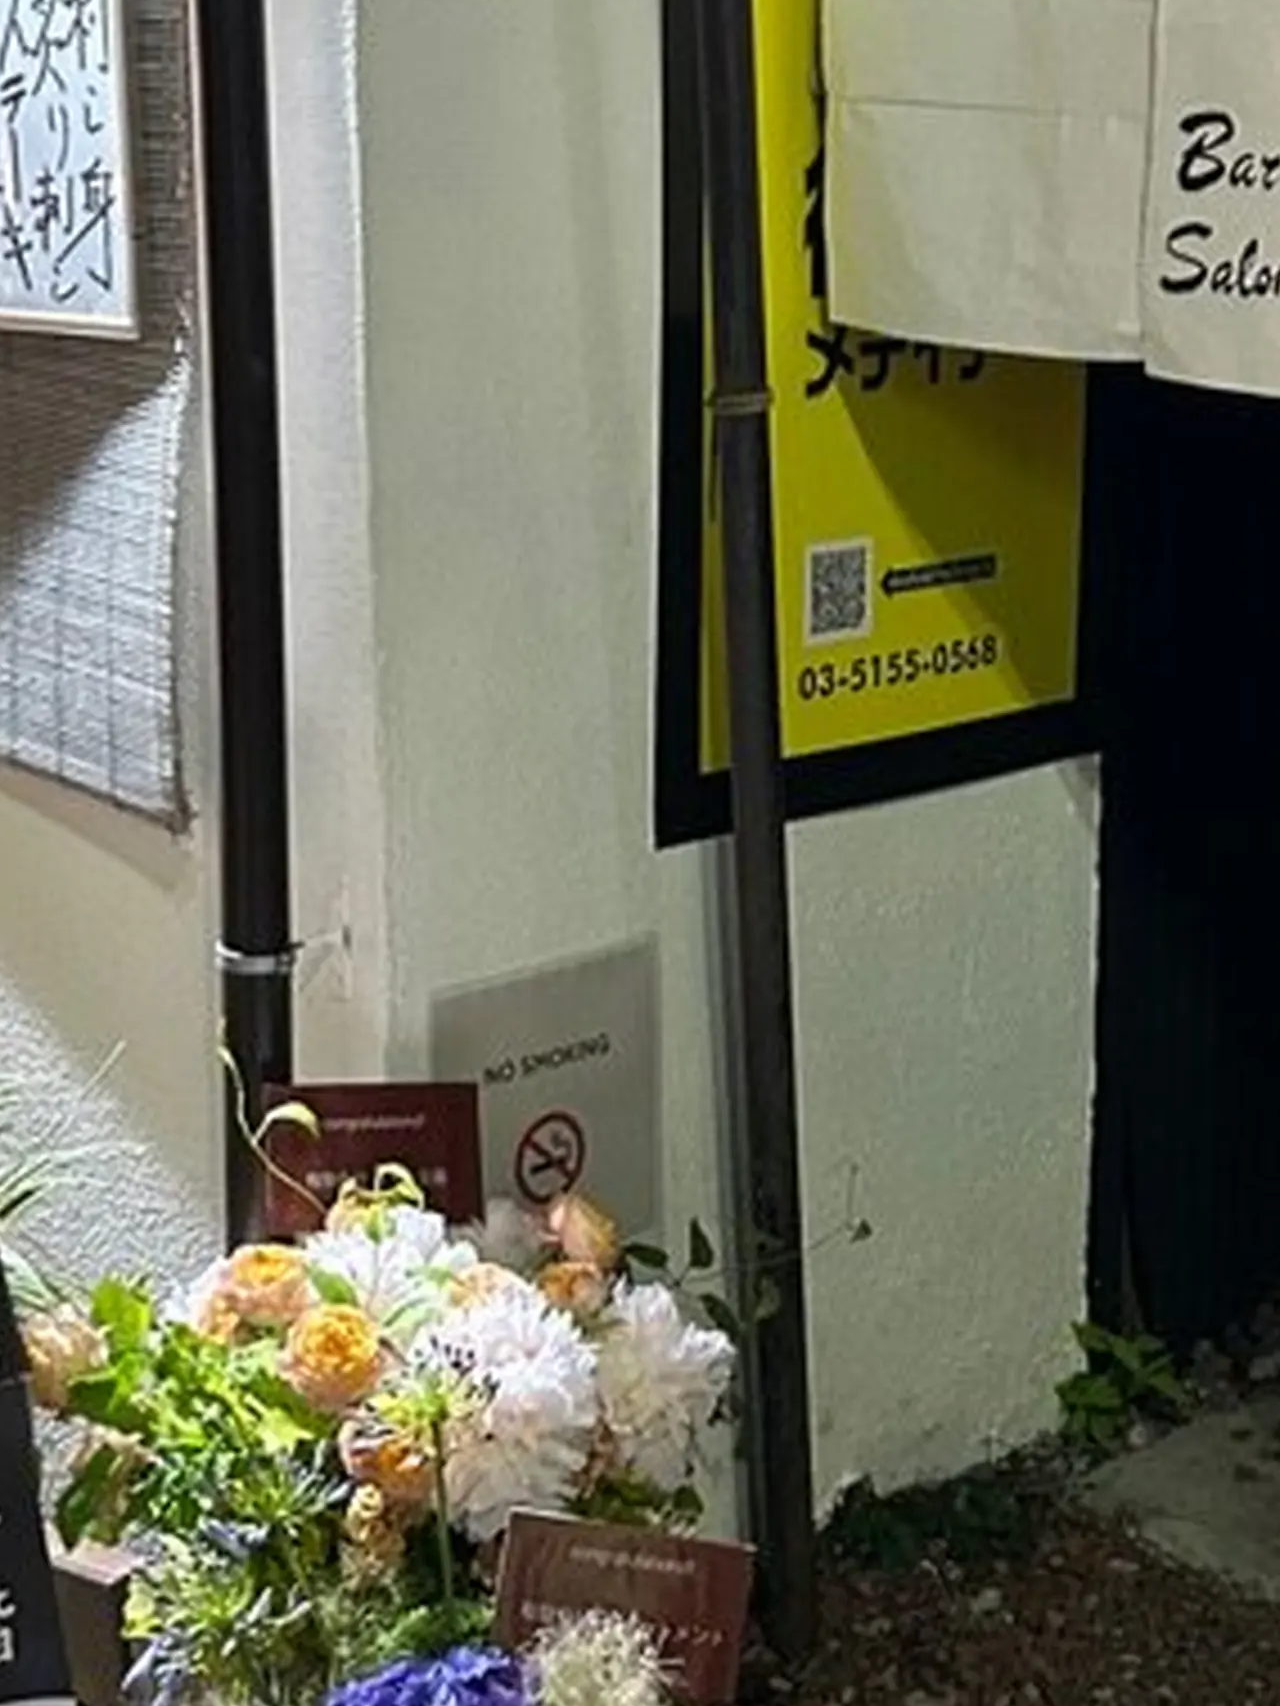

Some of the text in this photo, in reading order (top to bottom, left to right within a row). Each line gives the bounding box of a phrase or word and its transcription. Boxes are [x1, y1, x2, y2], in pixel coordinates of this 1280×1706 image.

[798, 634, 997, 701] 03-5155-0568
[482, 1031, 611, 1086] NO SMOKING
